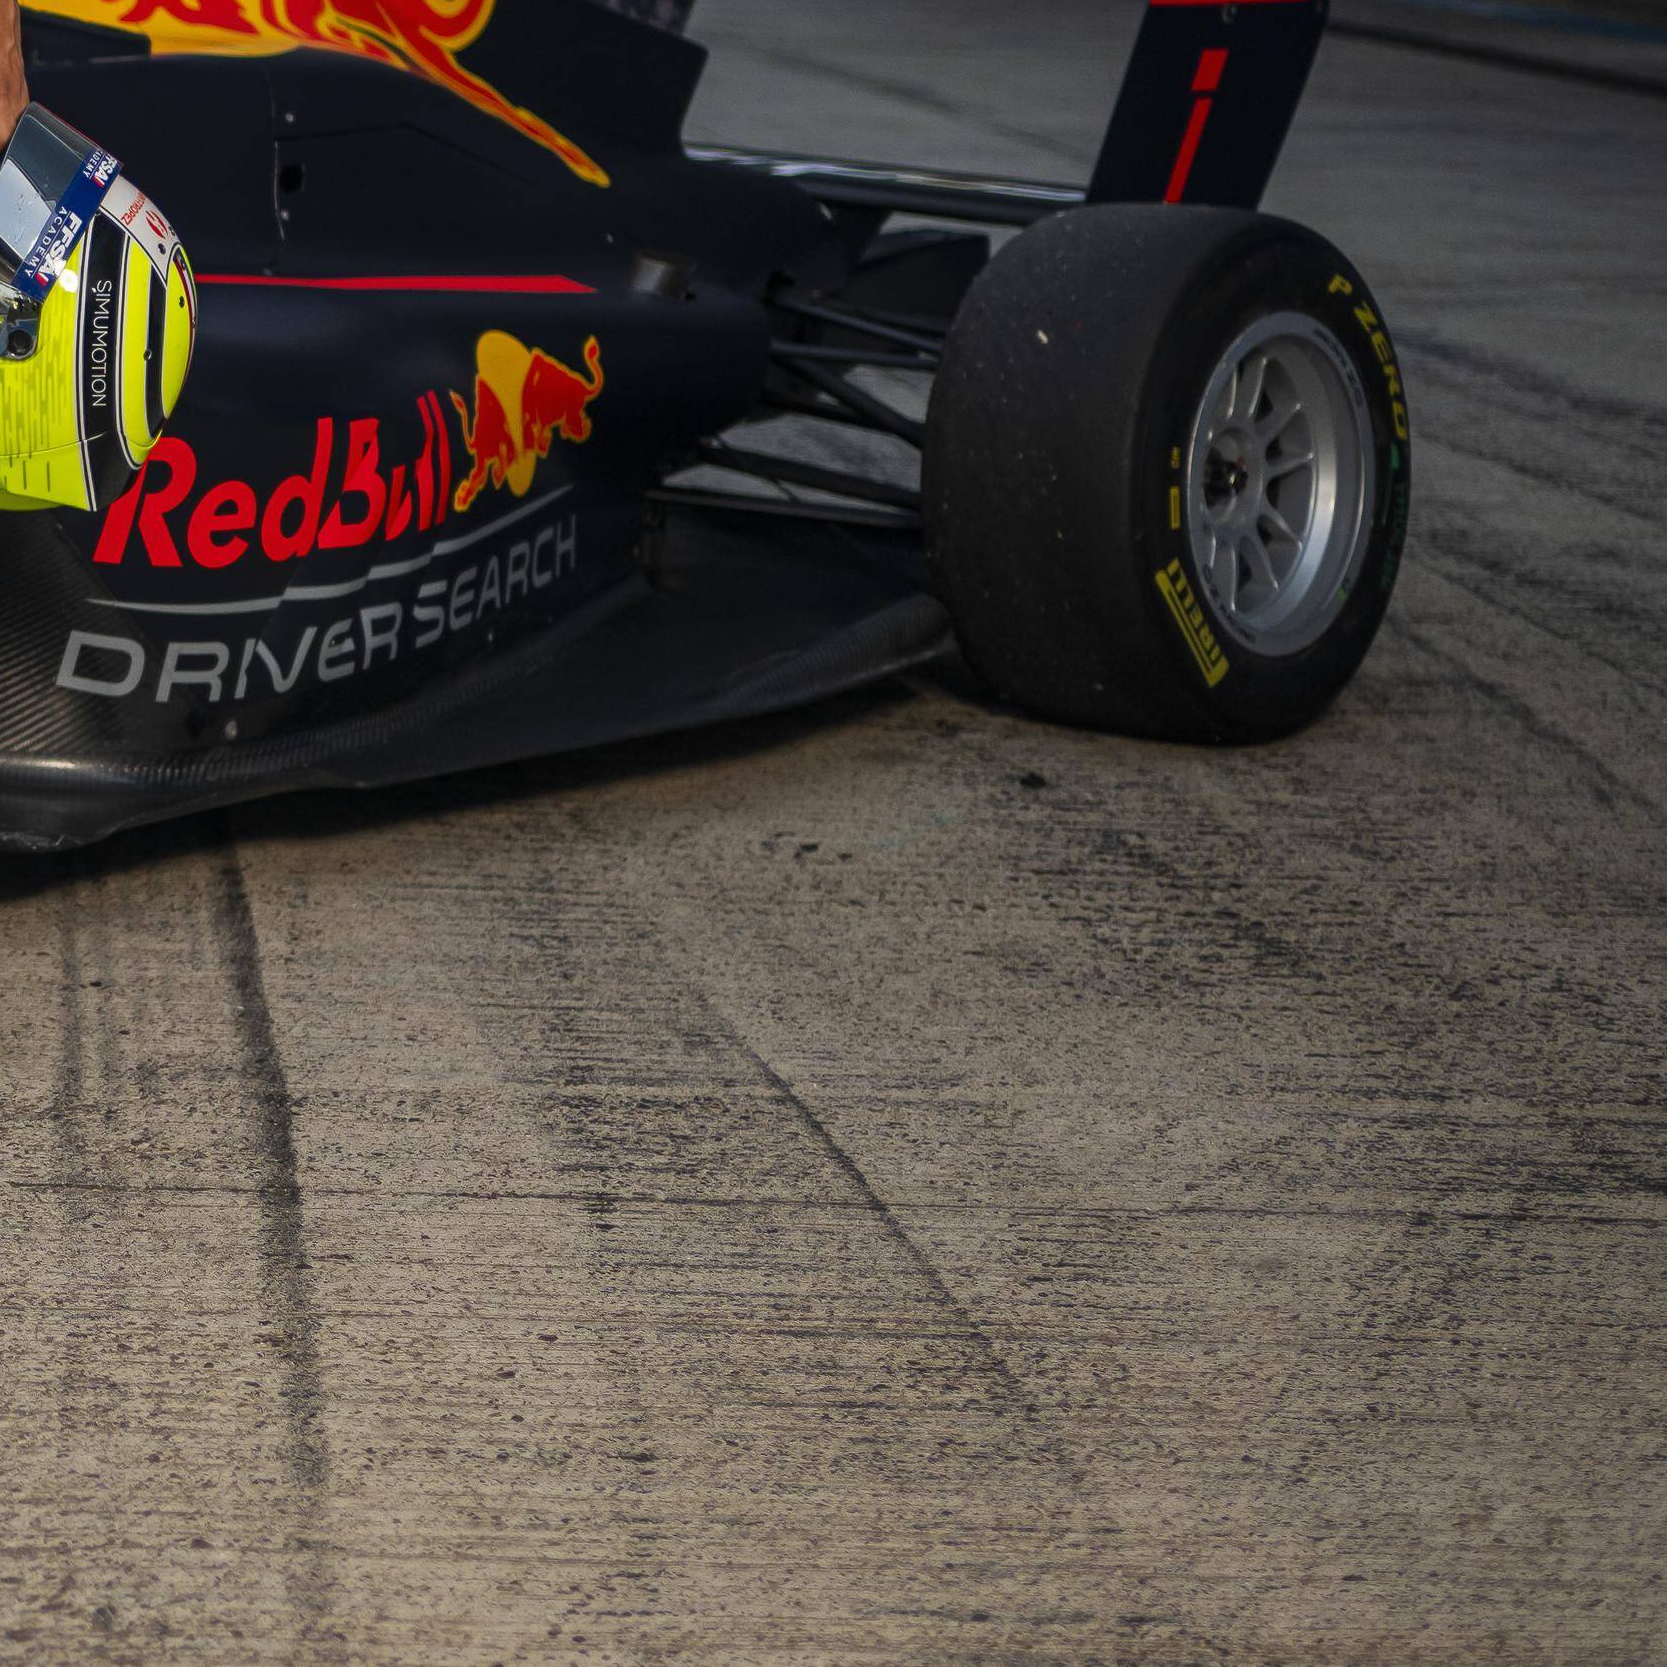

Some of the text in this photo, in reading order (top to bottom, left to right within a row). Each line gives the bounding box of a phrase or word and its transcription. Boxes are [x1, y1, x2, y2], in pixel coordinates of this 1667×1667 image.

[24, 206, 68, 278] ACADEMY
[37, 212, 83, 285] FFSA
[91, 279, 113, 407] SIMUMOTION
[1327, 274, 1353, 296] P
[1353, 301, 1408, 441] ZERO
[93, 390, 452, 570] Red Bull
[55, 515, 577, 703] DRIVER SEARCH
